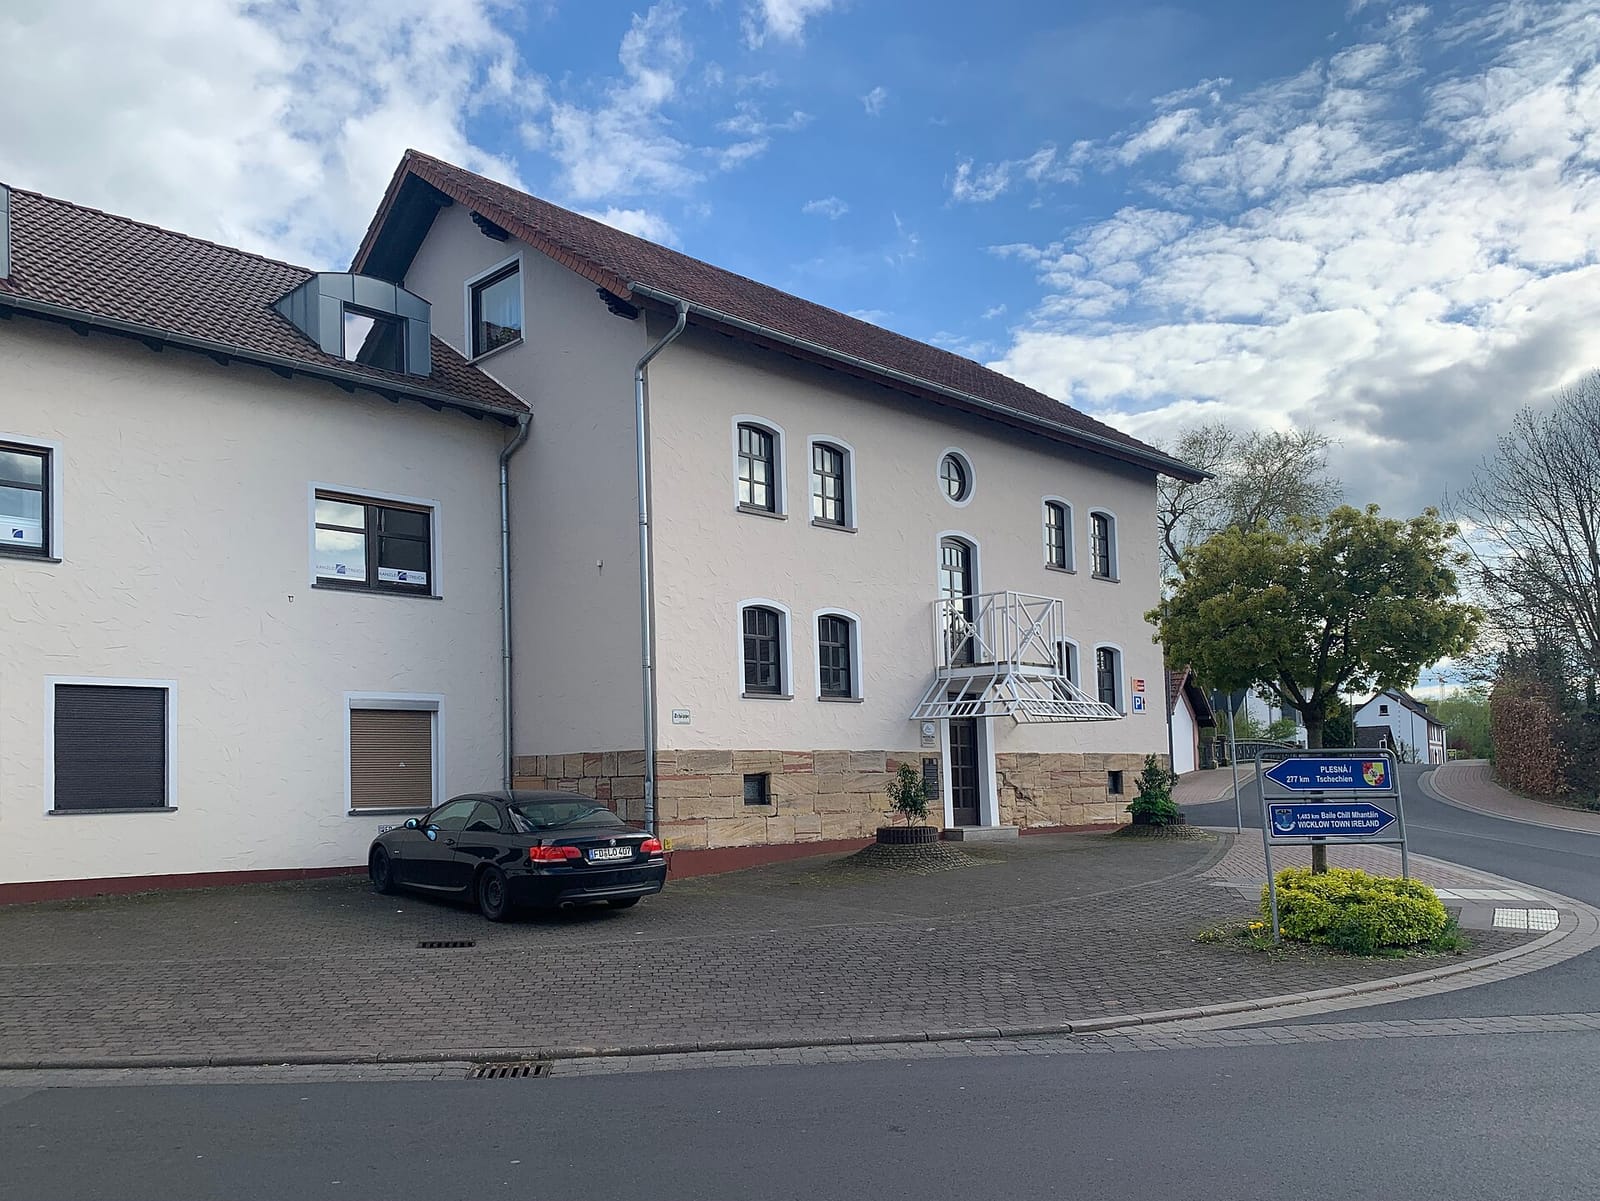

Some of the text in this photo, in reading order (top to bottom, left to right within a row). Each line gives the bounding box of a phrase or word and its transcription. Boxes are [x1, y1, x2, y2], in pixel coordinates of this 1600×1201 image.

[1135, 697, 1141, 709] P
[1286, 775, 1353, 783] 277 km Tschechien
[1297, 819, 1380, 829] WICKLOW TOWN IRELAND
